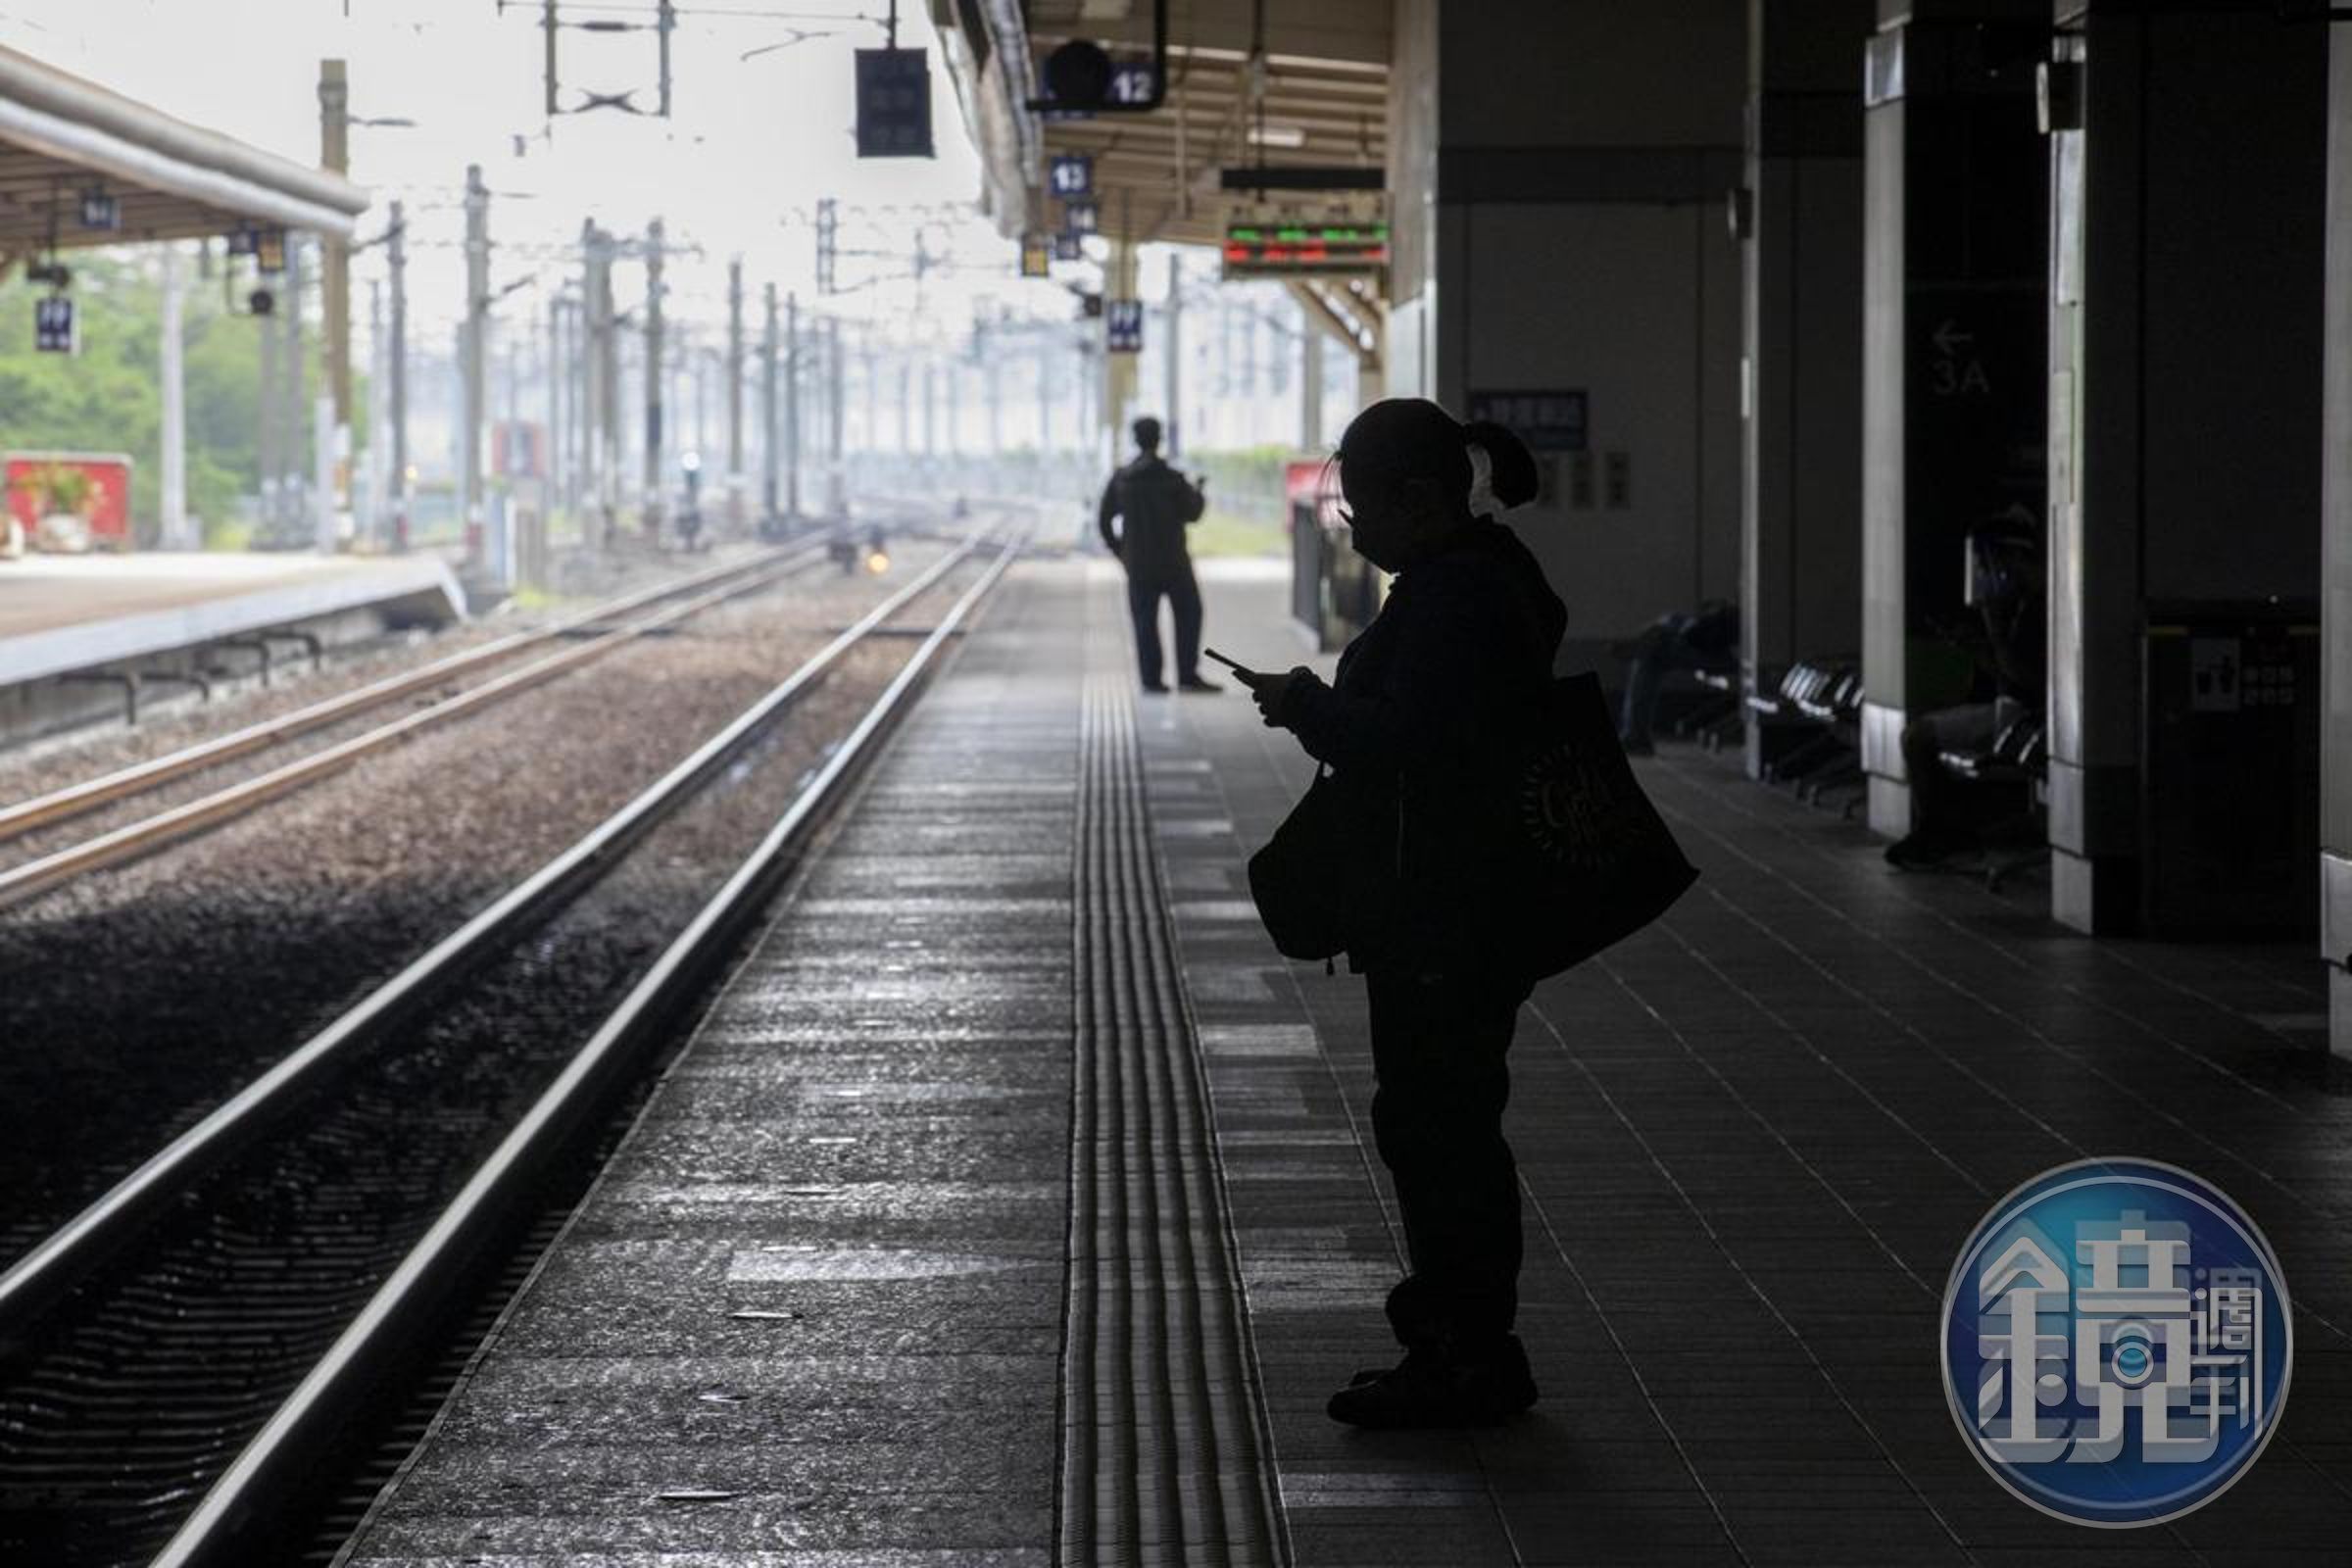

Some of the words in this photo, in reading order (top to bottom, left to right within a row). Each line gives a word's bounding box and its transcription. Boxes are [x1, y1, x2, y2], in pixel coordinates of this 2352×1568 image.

[1112, 71, 1152, 103] 12
[1054, 163, 1086, 191] 13
[1933, 360, 1990, 394] 3A
